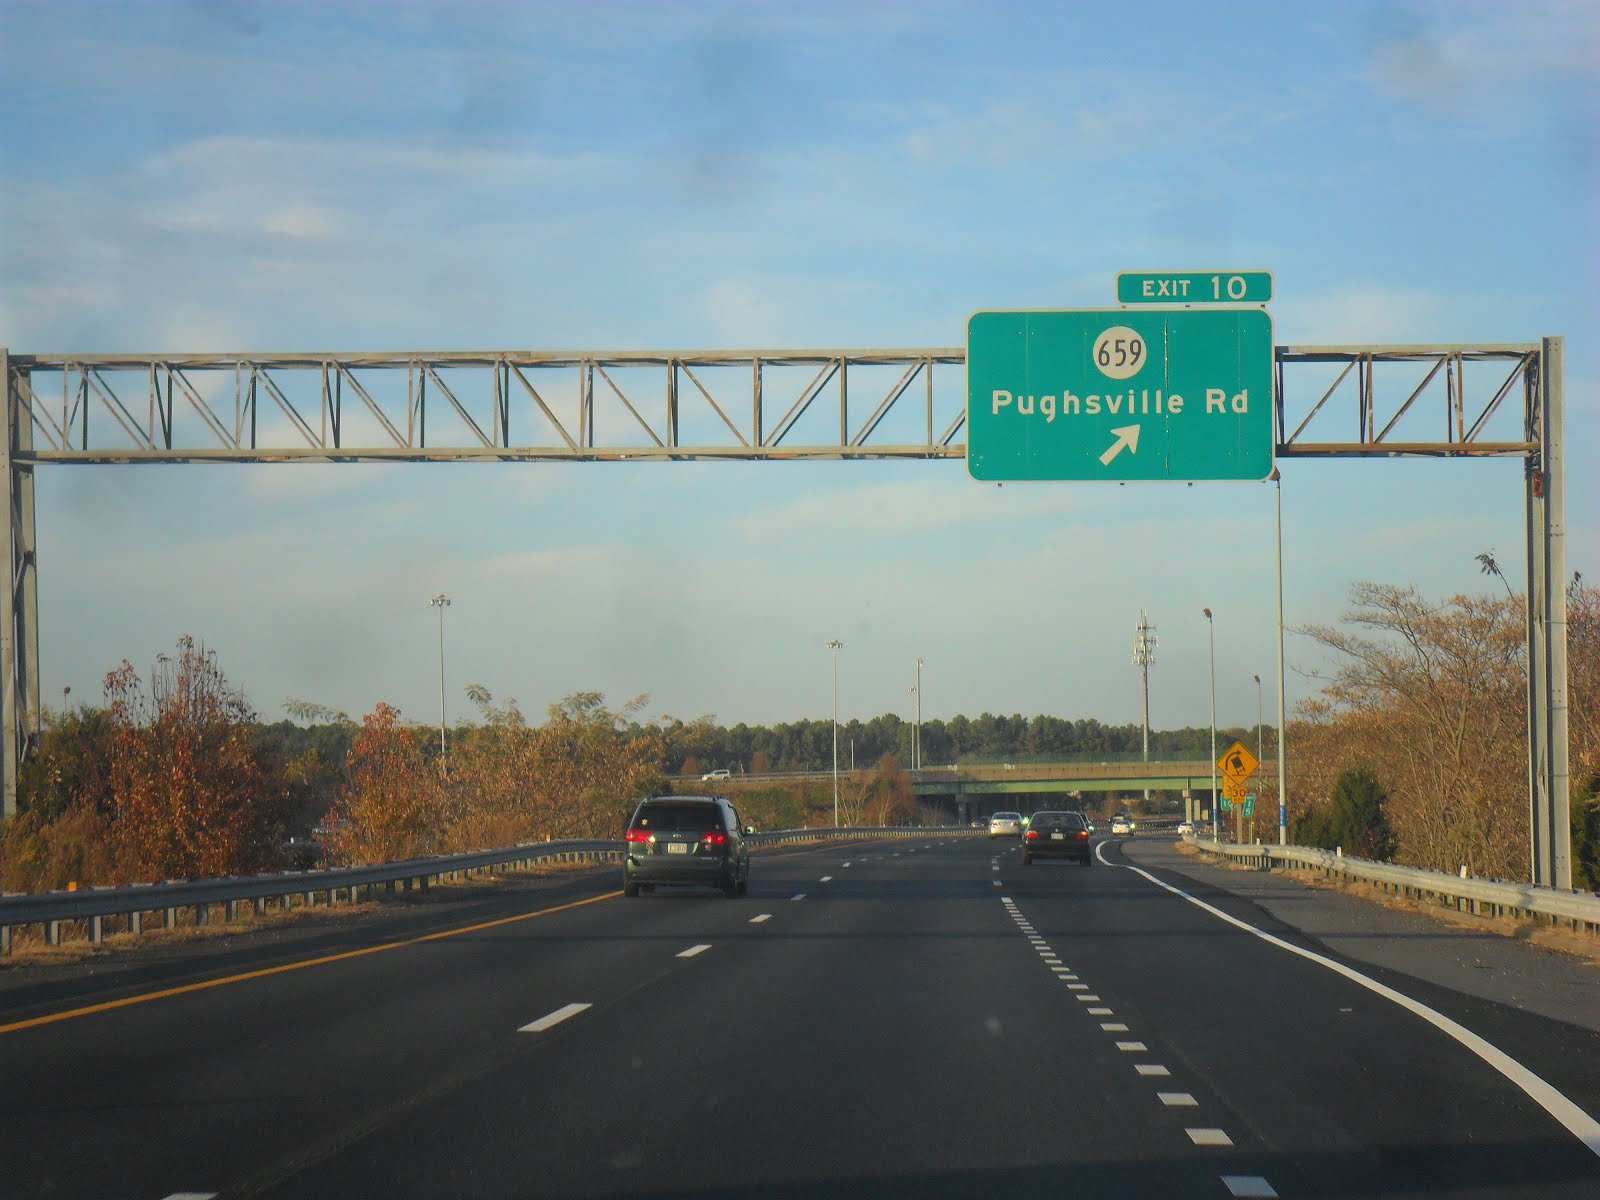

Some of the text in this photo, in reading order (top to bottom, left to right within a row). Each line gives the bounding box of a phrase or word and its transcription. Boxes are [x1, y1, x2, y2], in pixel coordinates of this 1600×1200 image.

[1142, 275, 1247, 299] EXIT 10
[1098, 339, 1142, 367] 659
[992, 388, 1248, 423] Pughsville Rd
[1232, 789, 1246, 797] 30
